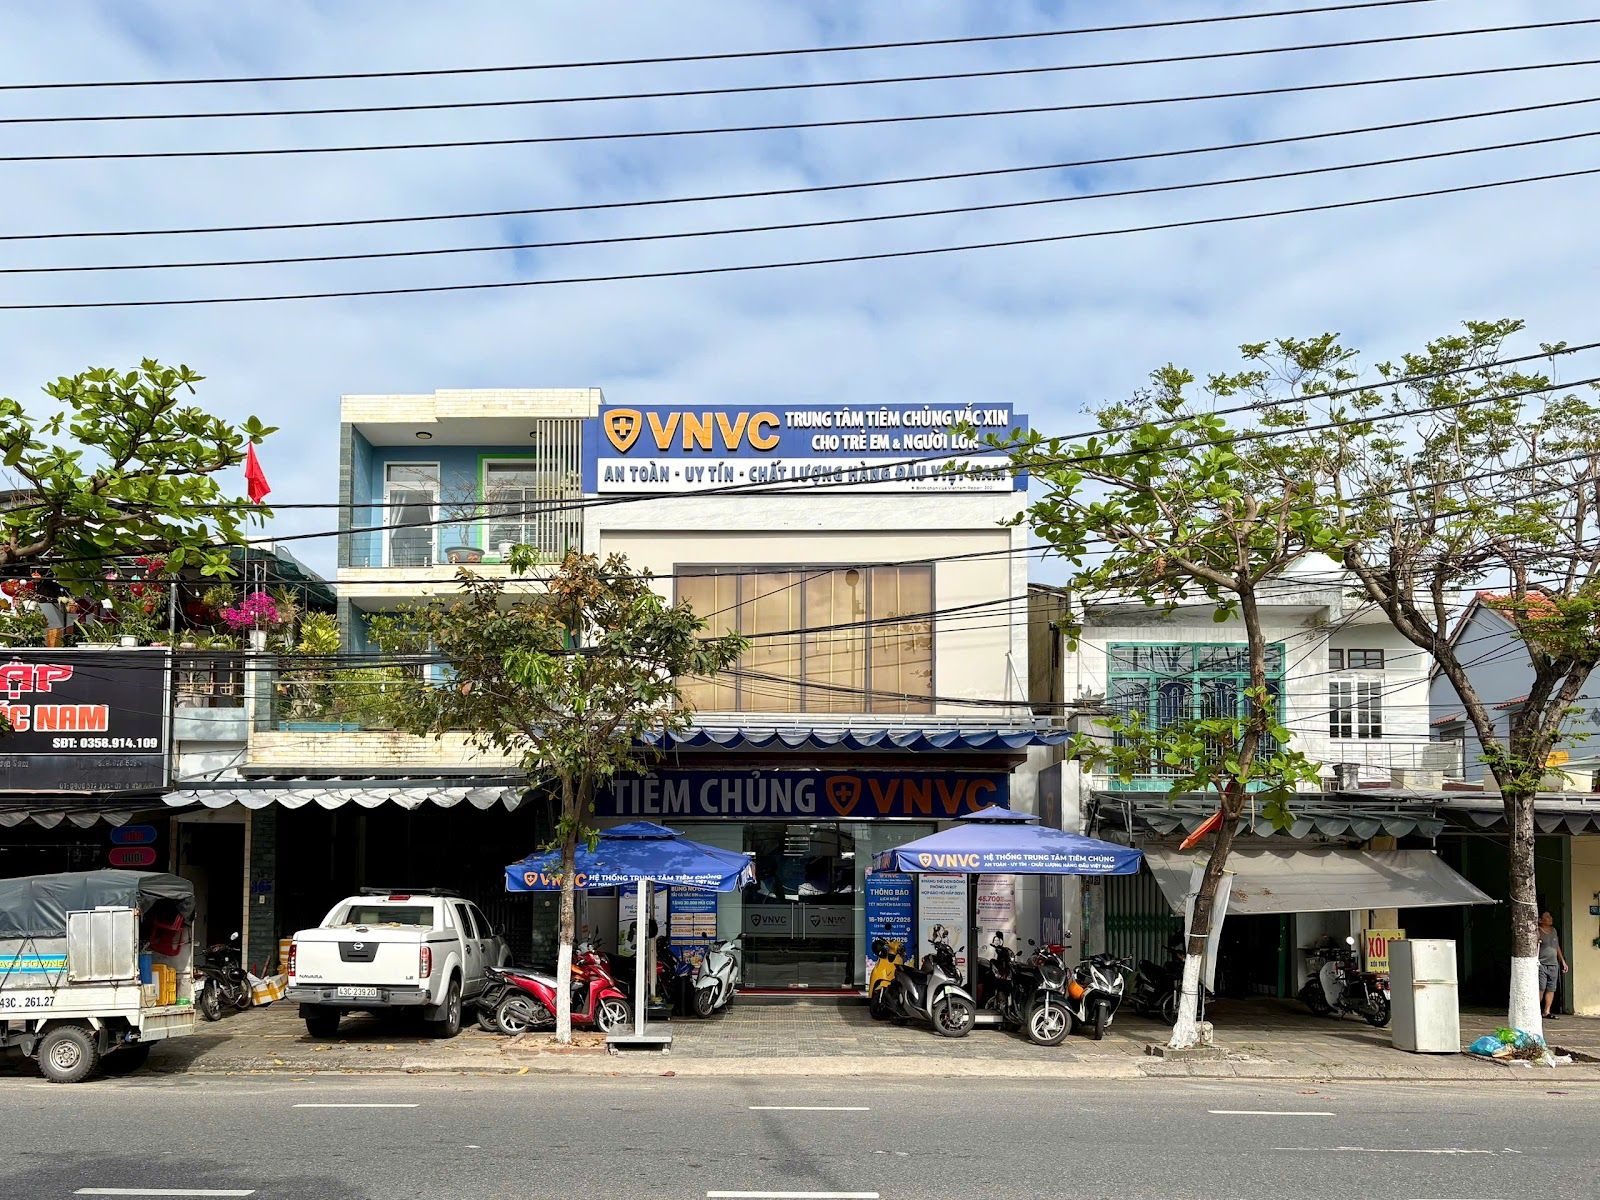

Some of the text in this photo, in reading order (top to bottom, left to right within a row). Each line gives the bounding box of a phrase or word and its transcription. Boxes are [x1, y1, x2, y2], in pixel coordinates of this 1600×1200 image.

[785, 411, 832, 427] TRUNG
[834, 406, 864, 427] TÂM
[866, 406, 900, 427] TIÊM
[902, 405, 952, 426] CHỦNG
[983, 409, 1008, 426] XIN
[646, 411, 781, 450] VNVC
[811, 434, 840, 450] CHO
[842, 429, 866, 450] TRẺ
[869, 434, 890, 450] EM
[892, 438, 901, 450] &
[903, 429, 947, 449] NGƯỜI
[604, 465, 625, 483] AN
[630, 461, 670, 483] TOÀN
[685, 465, 704, 483] UY
[709, 461, 734, 483] TÍN
[749, 460, 787, 483] CHẤT
[792, 463, 843, 486] LƯỢNG
[849, 461, 891, 483] HÀNG
[34, 704, 109, 732] NAM
[53, 738, 158, 749] SĐT: 0358.914.109
[613, 771, 998, 814] TIÊM CHỦNG VNVC
[934, 853, 980, 868] VNVC
[983, 853, 994, 862] HỆ
[995, 852, 1021, 861] THỐNG
[1070, 854, 1086, 862] TIÊM
[1088, 854, 1115, 863] CHỦNG
[589, 873, 600, 882] HỆ
[601, 872, 629, 881] THỐNG
[657, 873, 674, 881] TÂM
[870, 888, 894, 896] THÔNG
[762, 916, 787, 924] VNVC
[1368, 933, 1386, 958] XÔI
[25, 996, 56, 1008] 261.27
